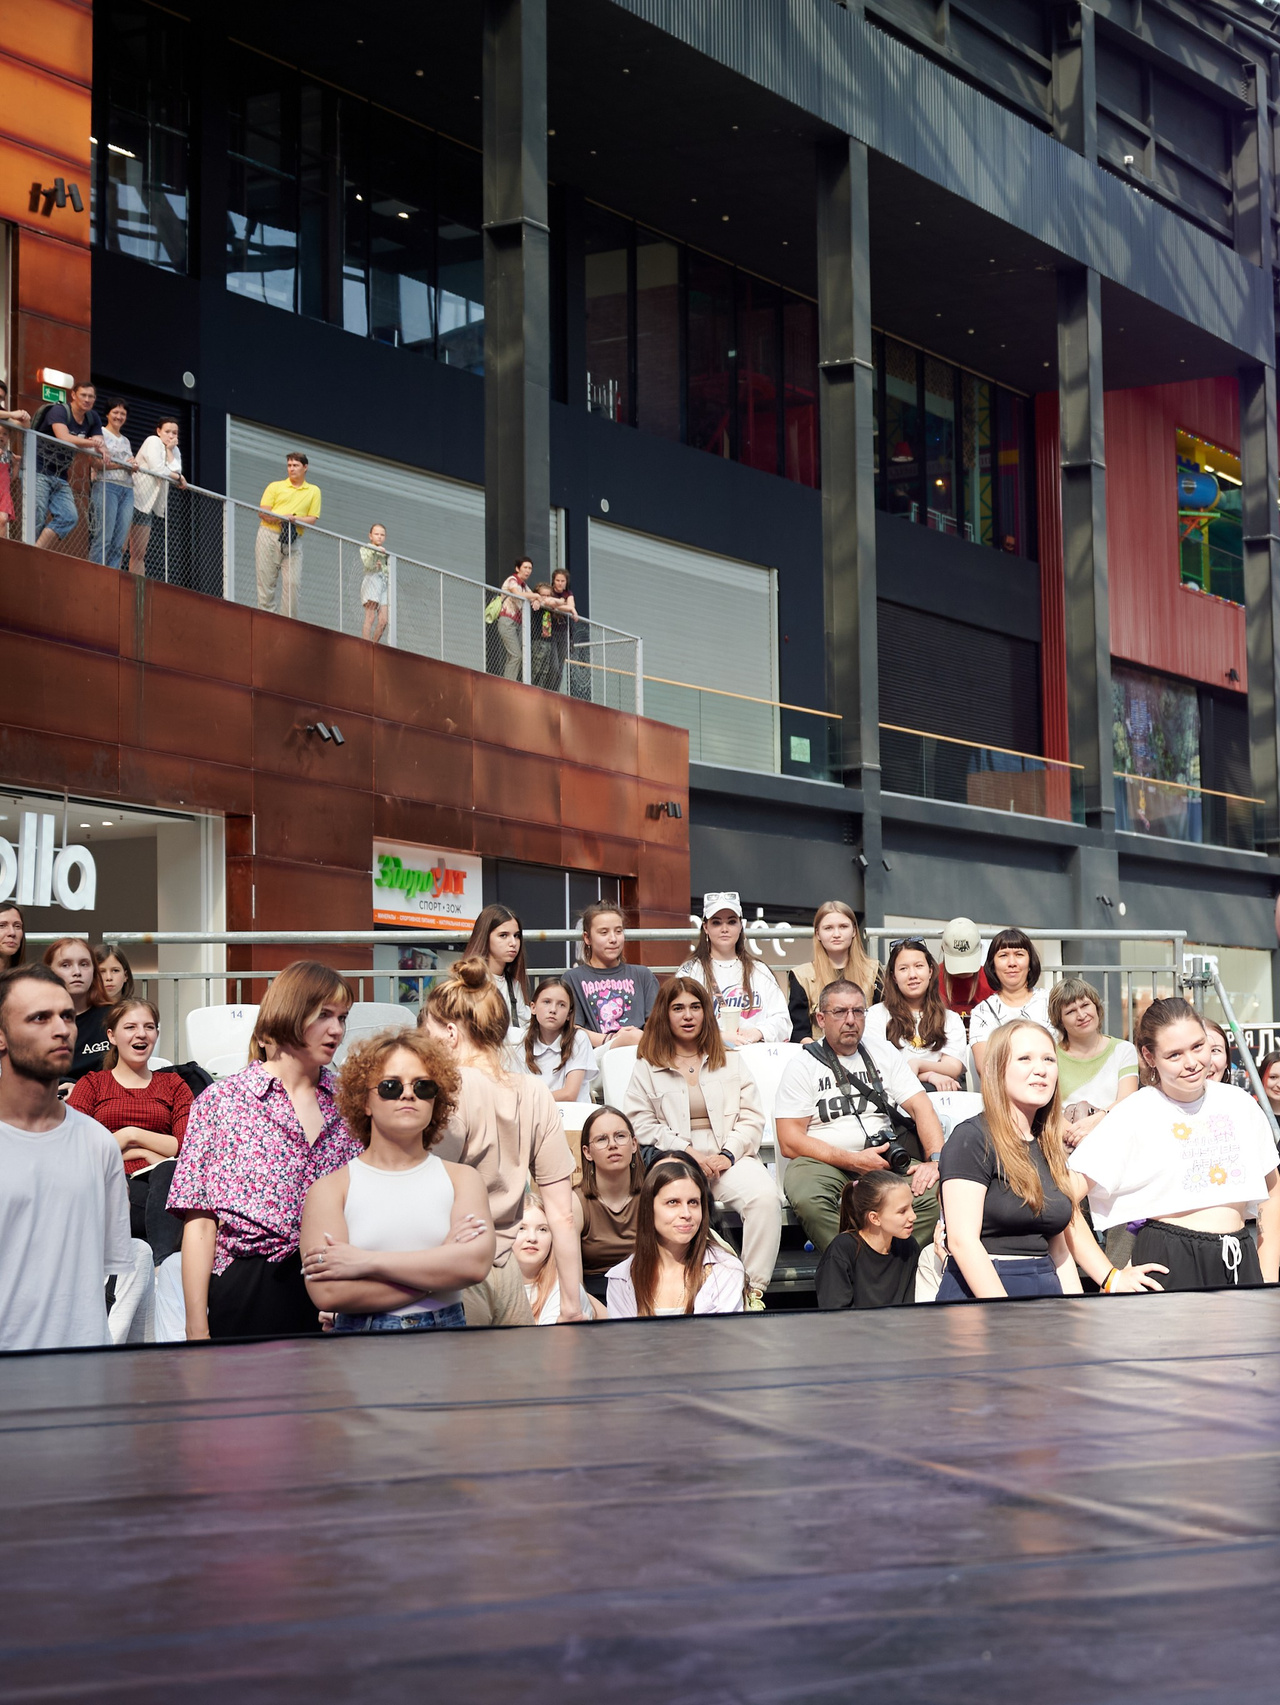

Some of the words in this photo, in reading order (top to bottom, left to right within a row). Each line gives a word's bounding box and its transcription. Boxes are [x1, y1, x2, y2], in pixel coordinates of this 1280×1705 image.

[419, 900, 441, 912] СПОРТ
[446, 903, 462, 914] ЗОЖ
[581, 978, 635, 999] DANGEROUS
[231, 1010, 244, 1019] 14
[82, 1040, 110, 1055] AGR
[767, 1048, 779, 1057] 14
[939, 1097, 951, 1106] 11
